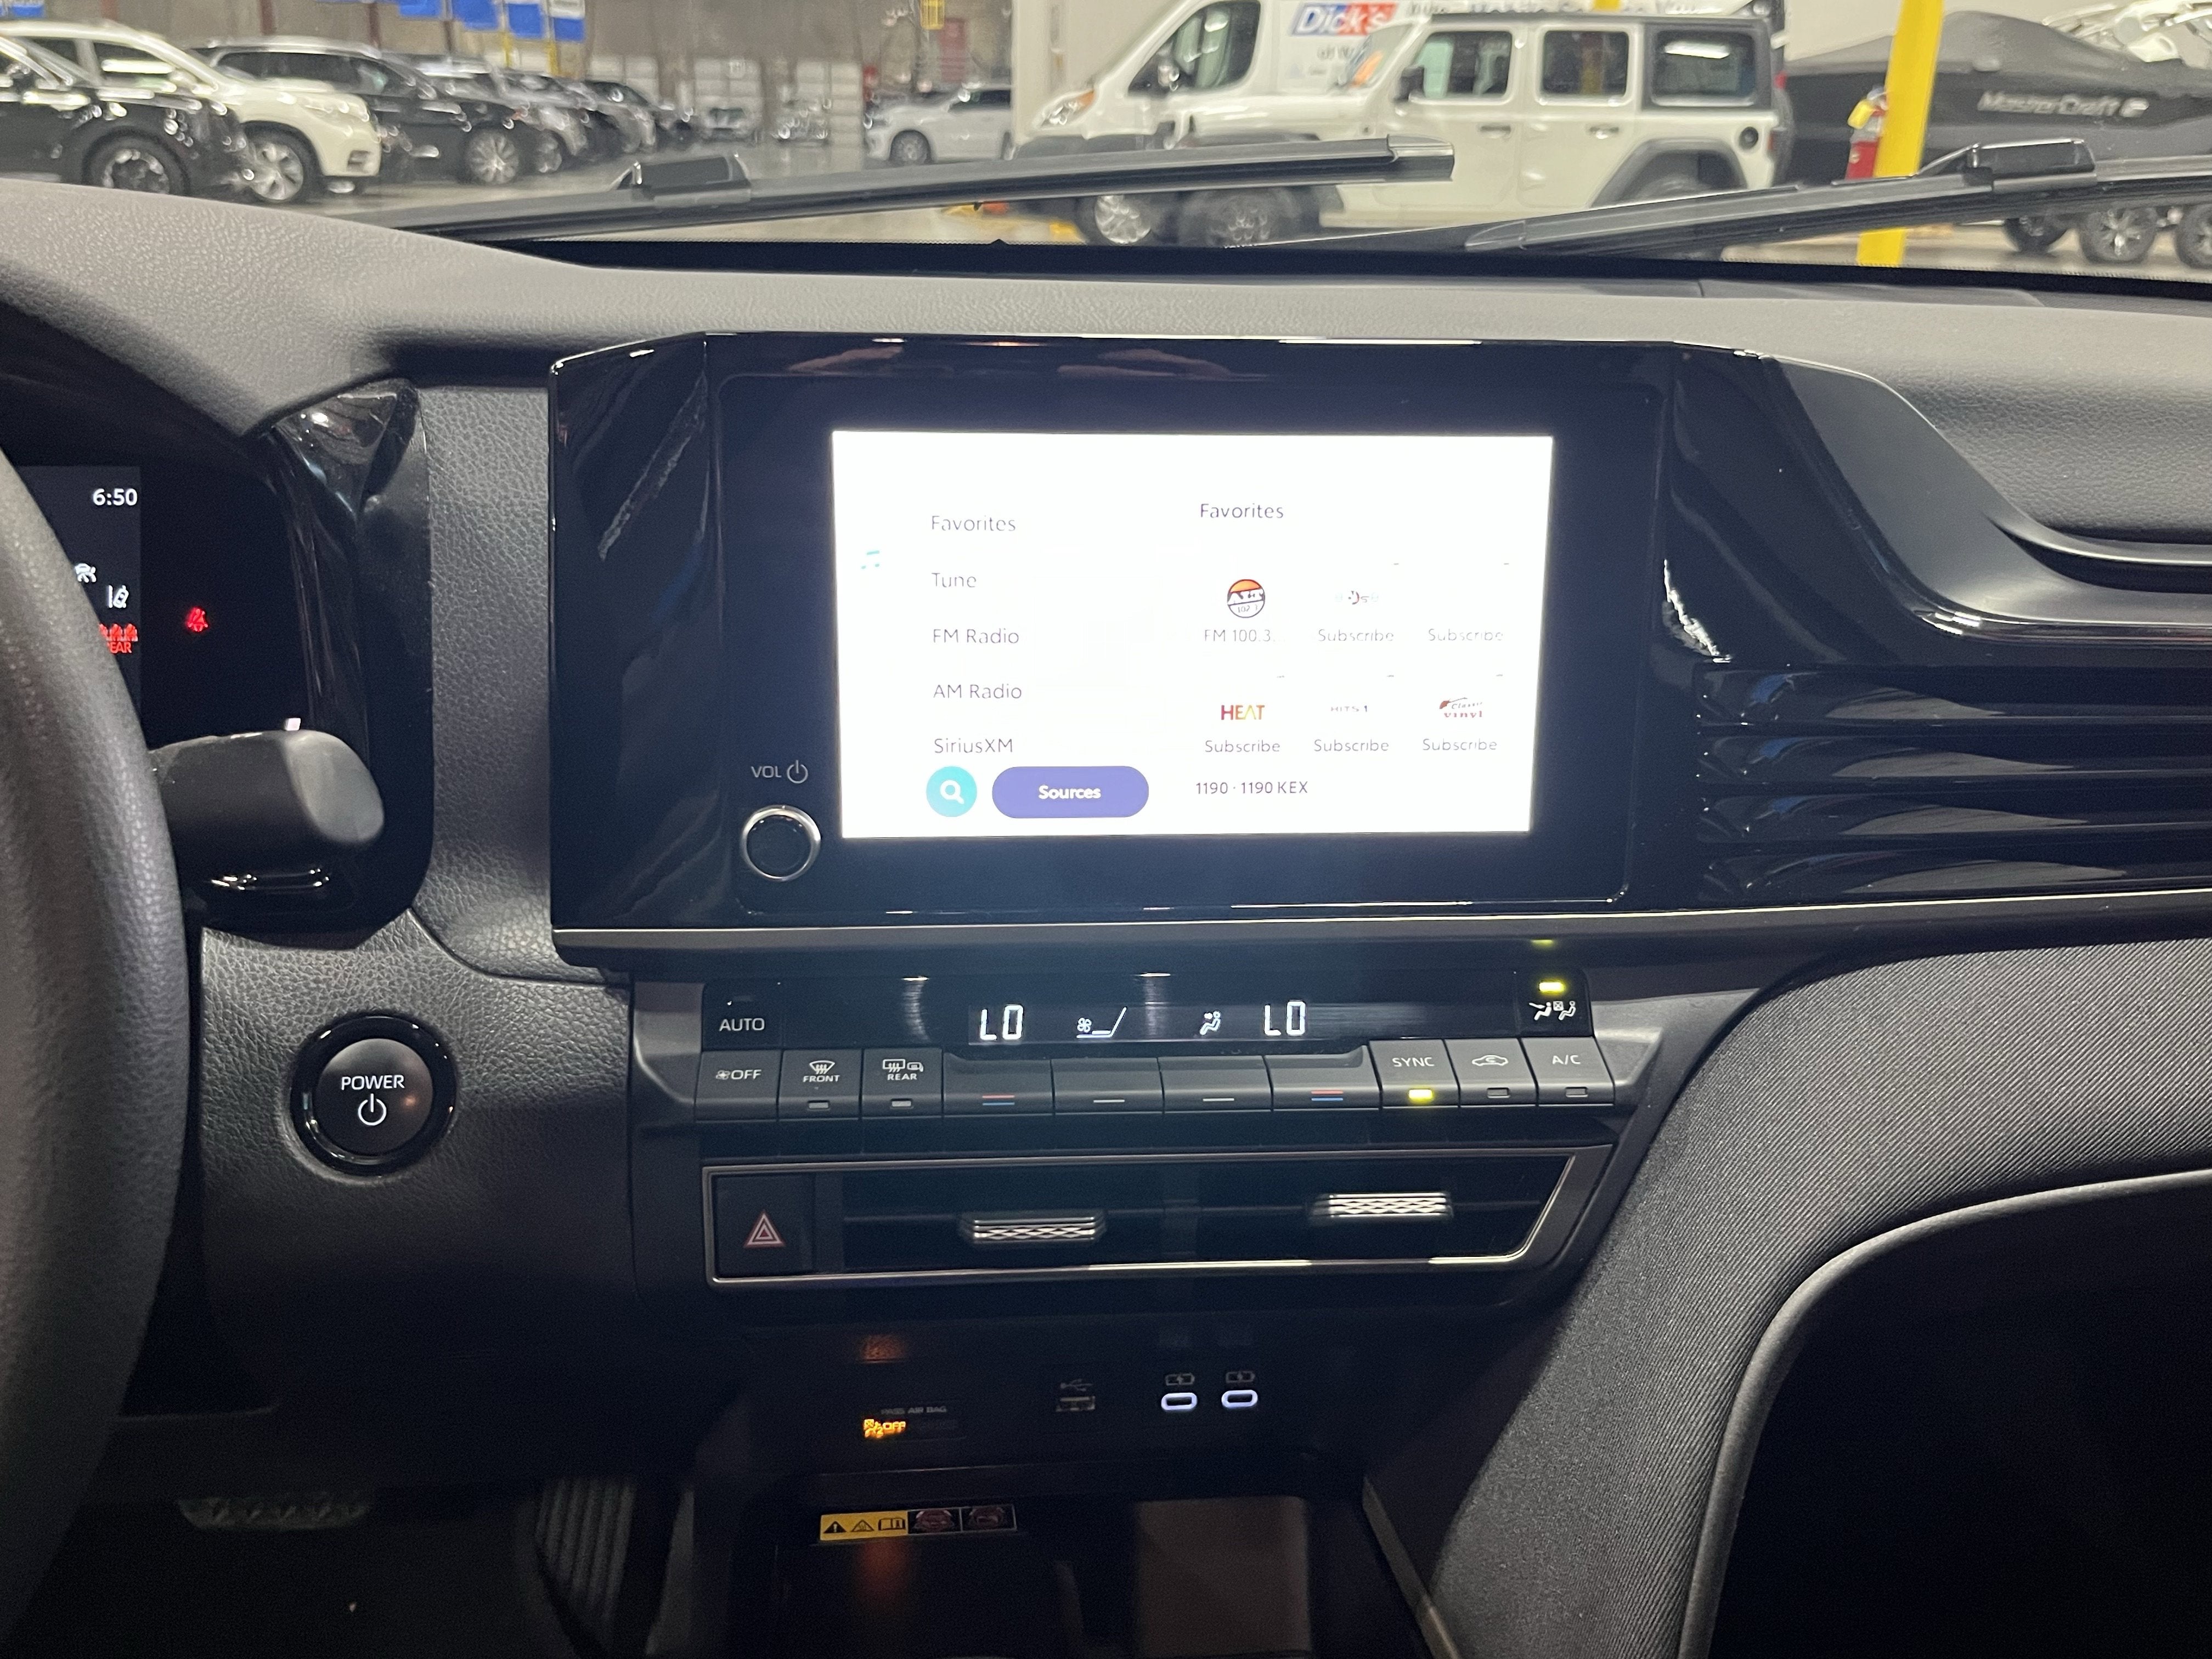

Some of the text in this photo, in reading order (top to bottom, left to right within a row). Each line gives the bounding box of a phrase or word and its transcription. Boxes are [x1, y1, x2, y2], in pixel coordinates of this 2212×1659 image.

[93, 488, 138, 506] 6:50
[1200, 503, 1284, 519] Favorites
[932, 515, 1016, 532] Favorites
[931, 572, 977, 588] Tune
[933, 627, 1019, 644] FM Radio
[1204, 629, 1226, 642] FM
[1318, 628, 1394, 642] Subscribe
[1428, 628, 1503, 641] Subscribe
[933, 683, 1022, 699] AM Radio
[1220, 704, 1266, 721] HEAT
[934, 737, 1013, 754] SiriusXM
[1204, 739, 1280, 753] Subscribe
[1313, 738, 1389, 752] Subscribe
[1422, 738, 1497, 751] Subscribe
[751, 766, 782, 778] VOL
[1038, 785, 1102, 800] Sources
[1195, 781, 1308, 794] 1190 1190 KEX
[719, 1018, 765, 1031] AUTO
[1392, 1057, 1435, 1068] SYNC
[1552, 1054, 1581, 1065] A/C
[731, 1069, 762, 1080] OFF
[341, 1074, 405, 1091] POWER
[882, 1421, 906, 1431] OFF
